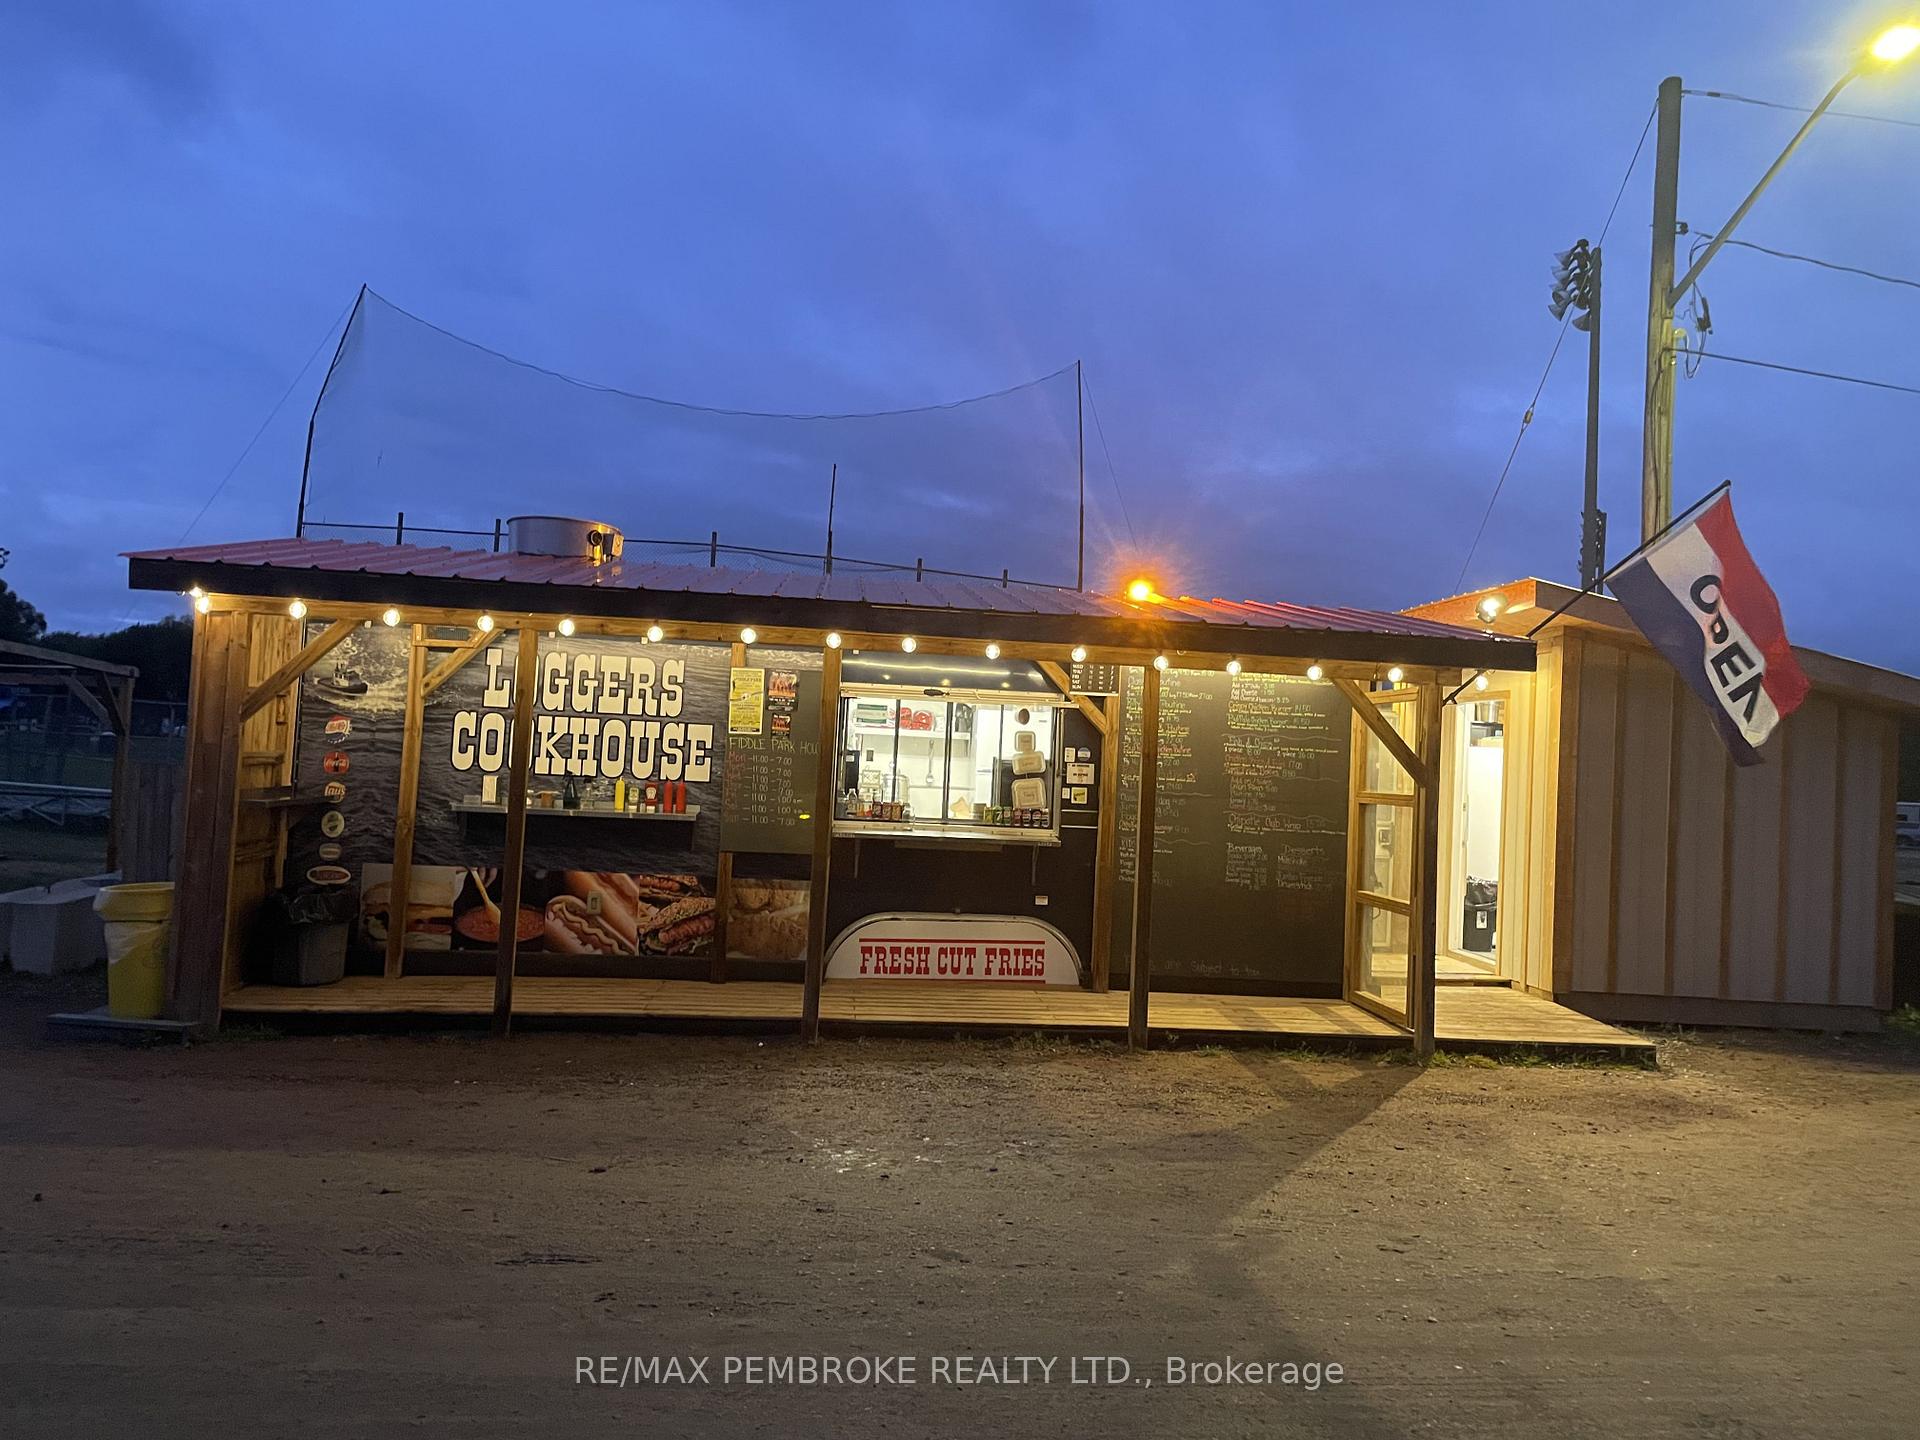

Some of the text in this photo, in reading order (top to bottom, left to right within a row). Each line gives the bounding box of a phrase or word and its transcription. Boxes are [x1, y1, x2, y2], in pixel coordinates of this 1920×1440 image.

[482, 648, 685, 718] LGGERS
[451, 710, 714, 783] COKHOUSE
[729, 736, 766, 750] FIDDLE
[771, 739, 796, 753] PARK
[859, 946, 1046, 977] FRESH CUT FRIES
